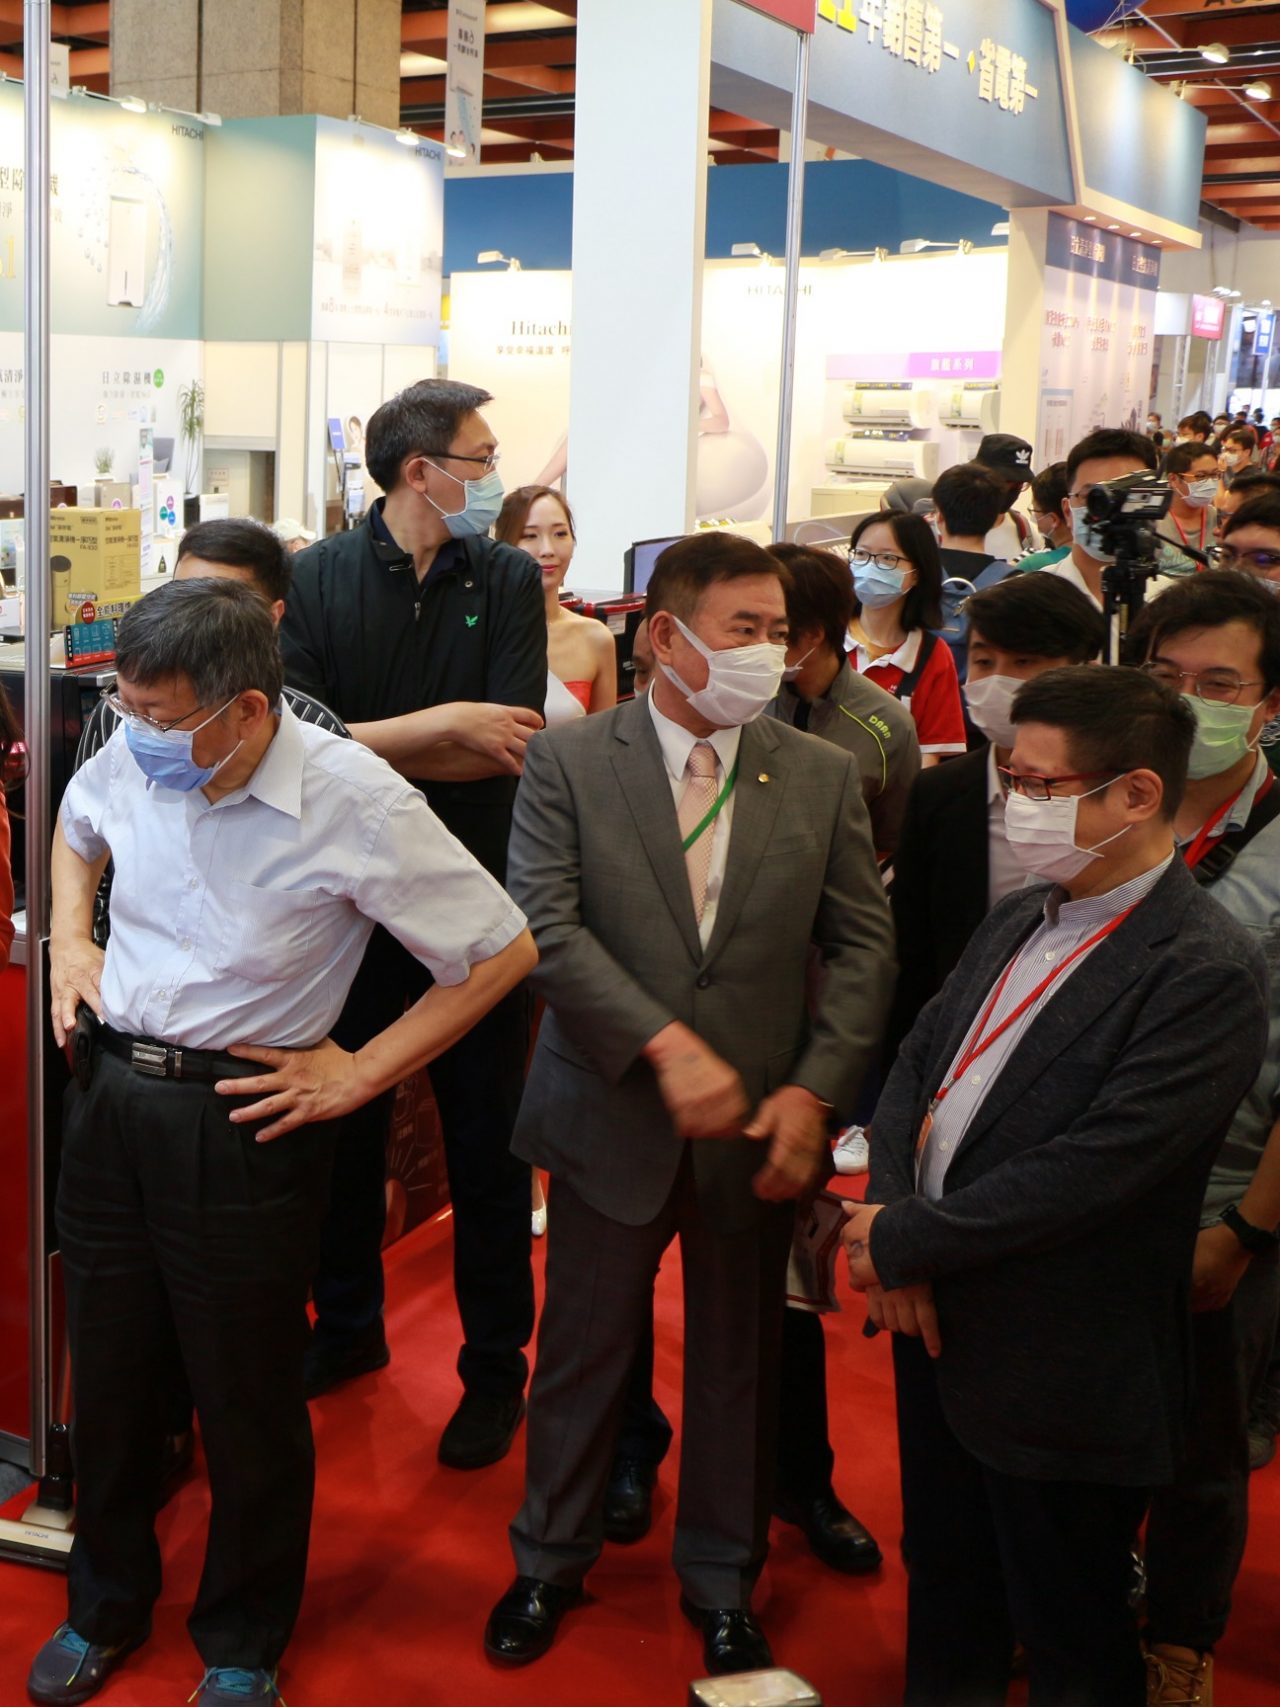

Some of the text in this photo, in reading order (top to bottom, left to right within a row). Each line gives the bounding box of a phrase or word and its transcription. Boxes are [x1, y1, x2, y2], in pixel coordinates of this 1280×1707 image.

[818, 0, 1038, 116] 年銷售第一 省電第一
